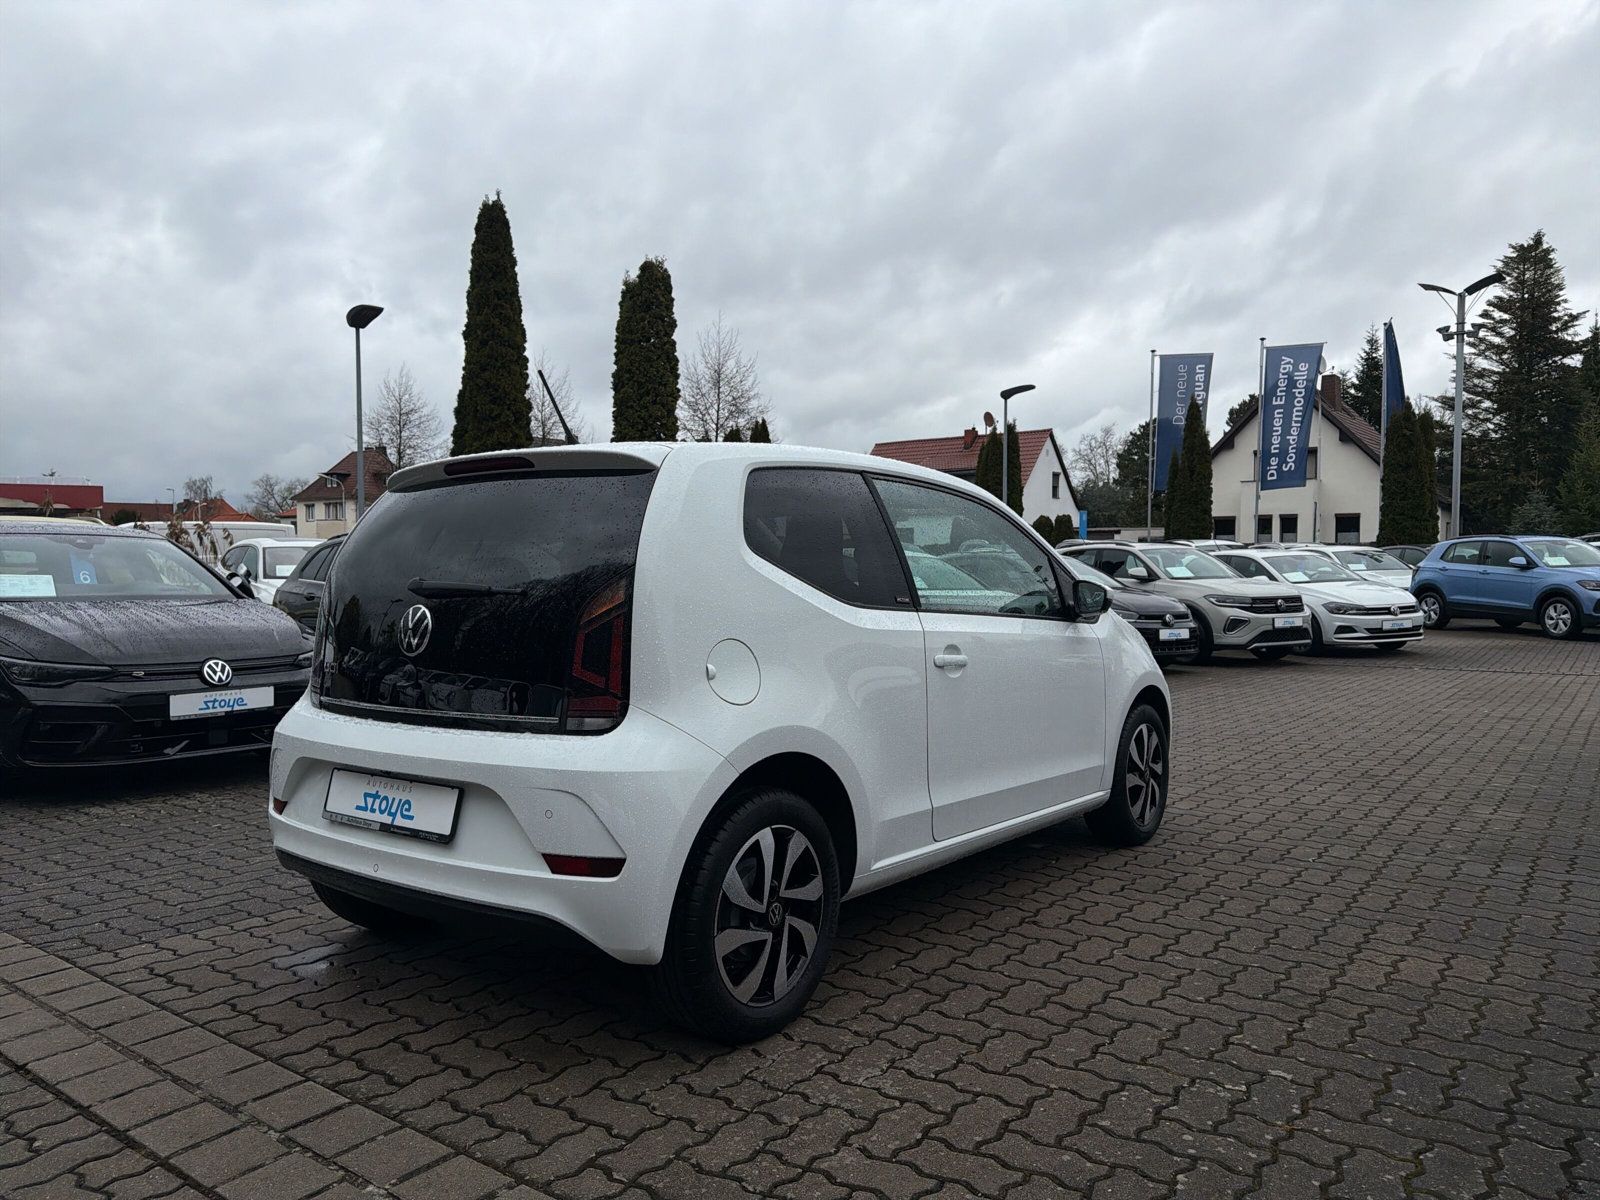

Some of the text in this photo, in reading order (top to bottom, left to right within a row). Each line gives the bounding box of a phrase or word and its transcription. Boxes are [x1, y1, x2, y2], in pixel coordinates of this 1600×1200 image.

[1172, 364, 1188, 425] Der neue
[1267, 356, 1294, 480] Die neuen Energy
[1282, 362, 1309, 471] Sondermodelle
[79, 570, 91, 584] 6
[366, 779, 414, 794] AUTOHAUS
